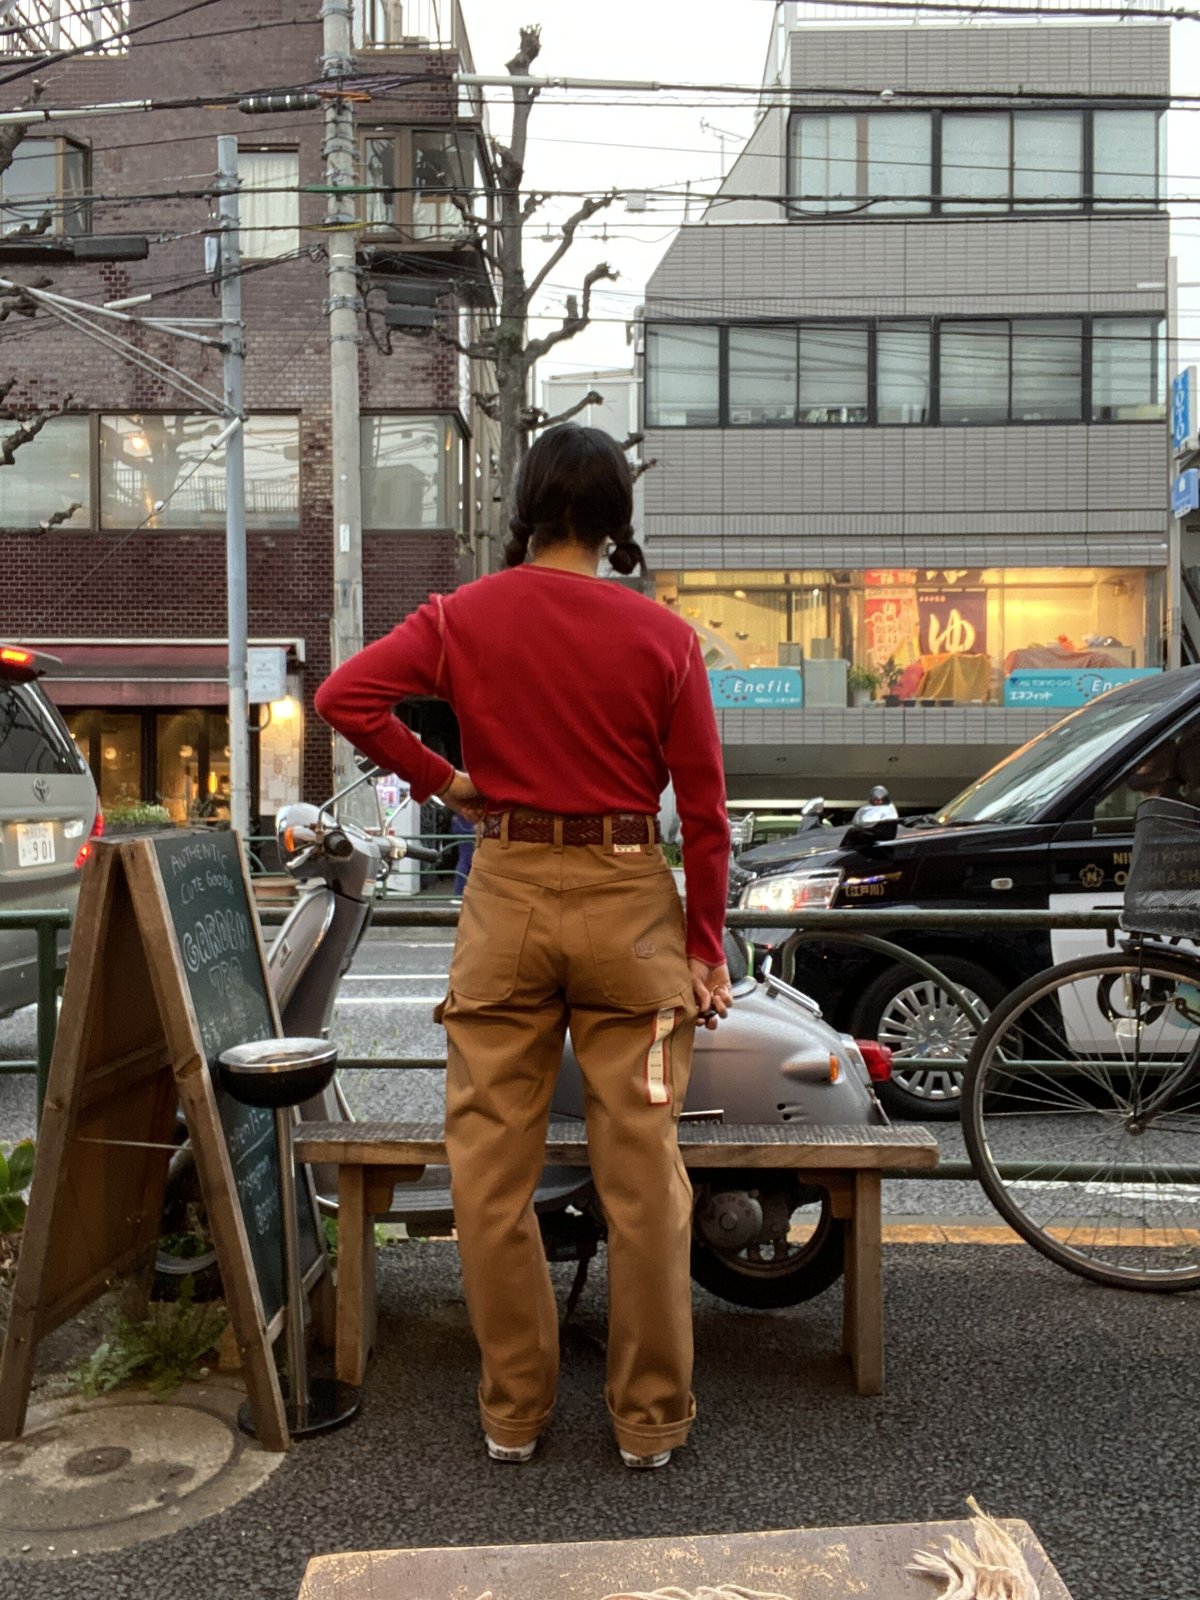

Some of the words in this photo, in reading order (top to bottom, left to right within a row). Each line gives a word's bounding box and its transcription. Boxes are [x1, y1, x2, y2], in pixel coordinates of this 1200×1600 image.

[733, 680, 791, 693] Enefit
[170, 843, 229, 876] AUTHENTIC
[183, 909, 251, 973] GARDEN
